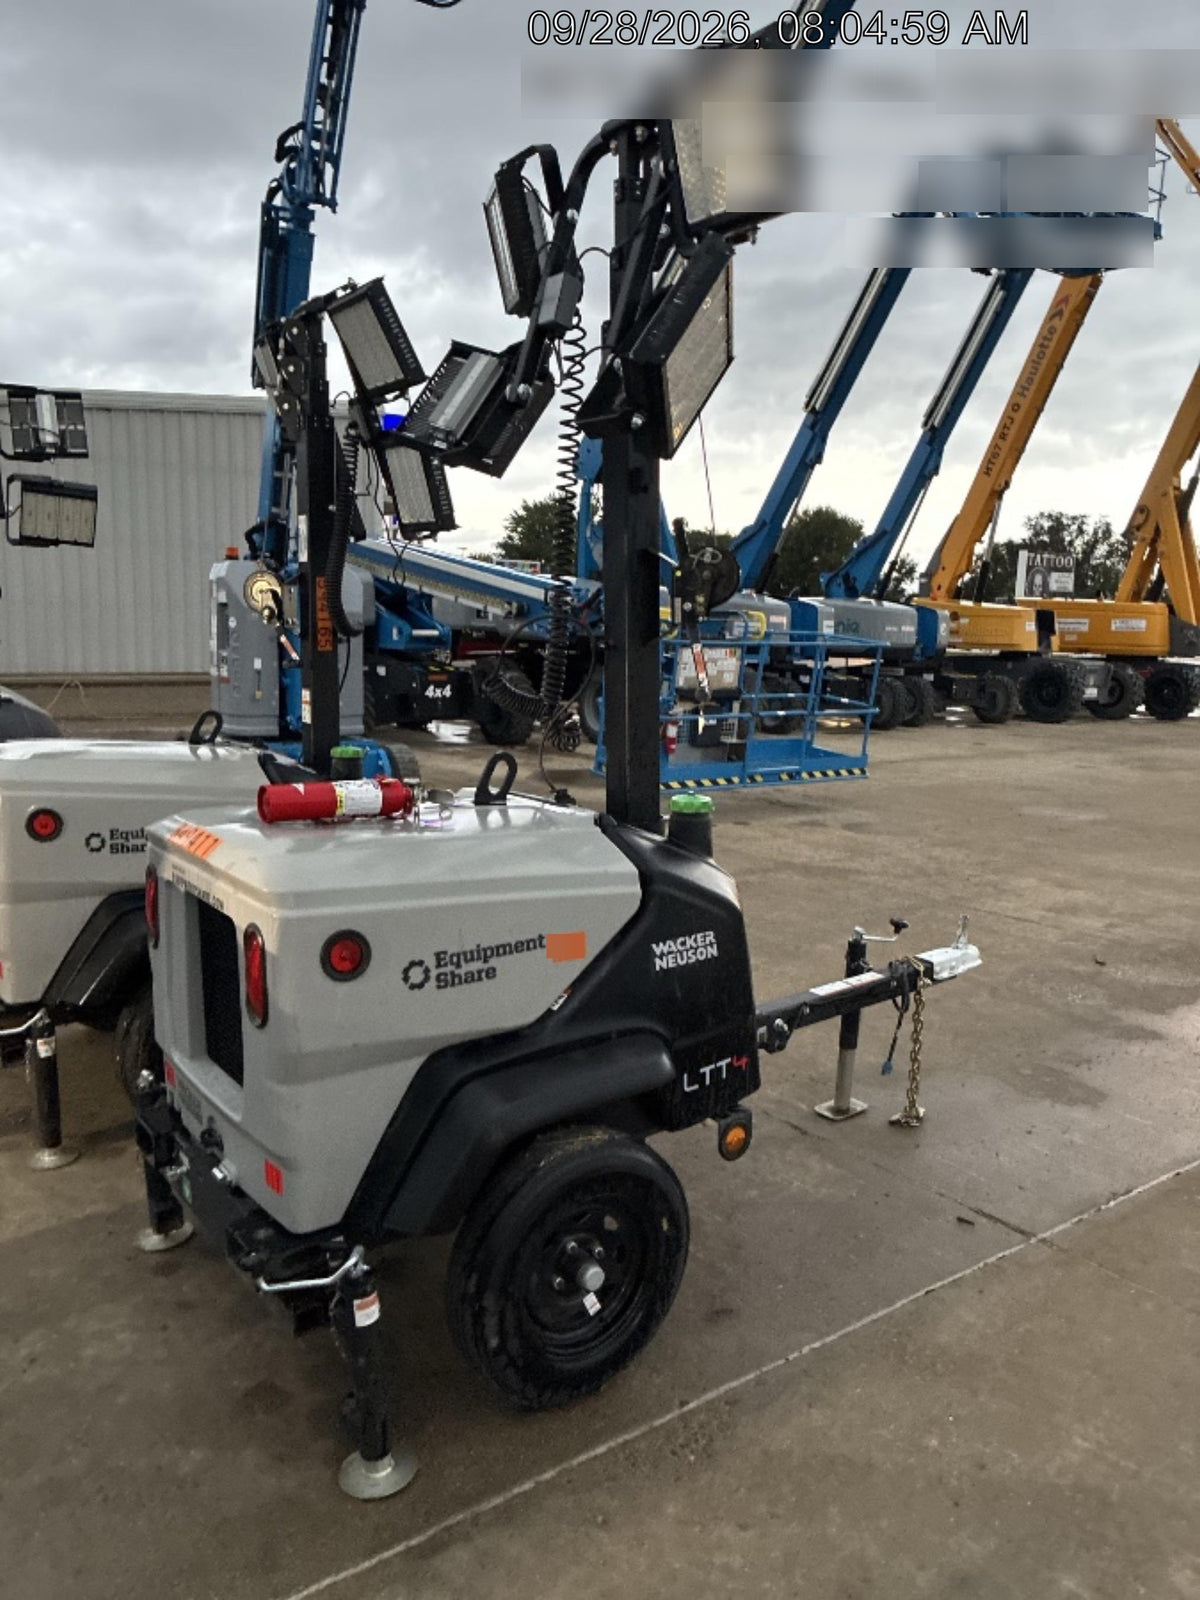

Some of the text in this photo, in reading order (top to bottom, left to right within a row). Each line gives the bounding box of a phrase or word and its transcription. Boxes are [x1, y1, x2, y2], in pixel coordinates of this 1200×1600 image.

[1017, 325, 1057, 398] Haulotte
[1028, 552, 1074, 568] TATTOO
[424, 684, 452, 698] 4x4
[434, 933, 546, 969] Equipment
[651, 931, 717, 956] WACKER
[654, 943, 718, 971] NEUSON
[434, 966, 497, 989] Share
